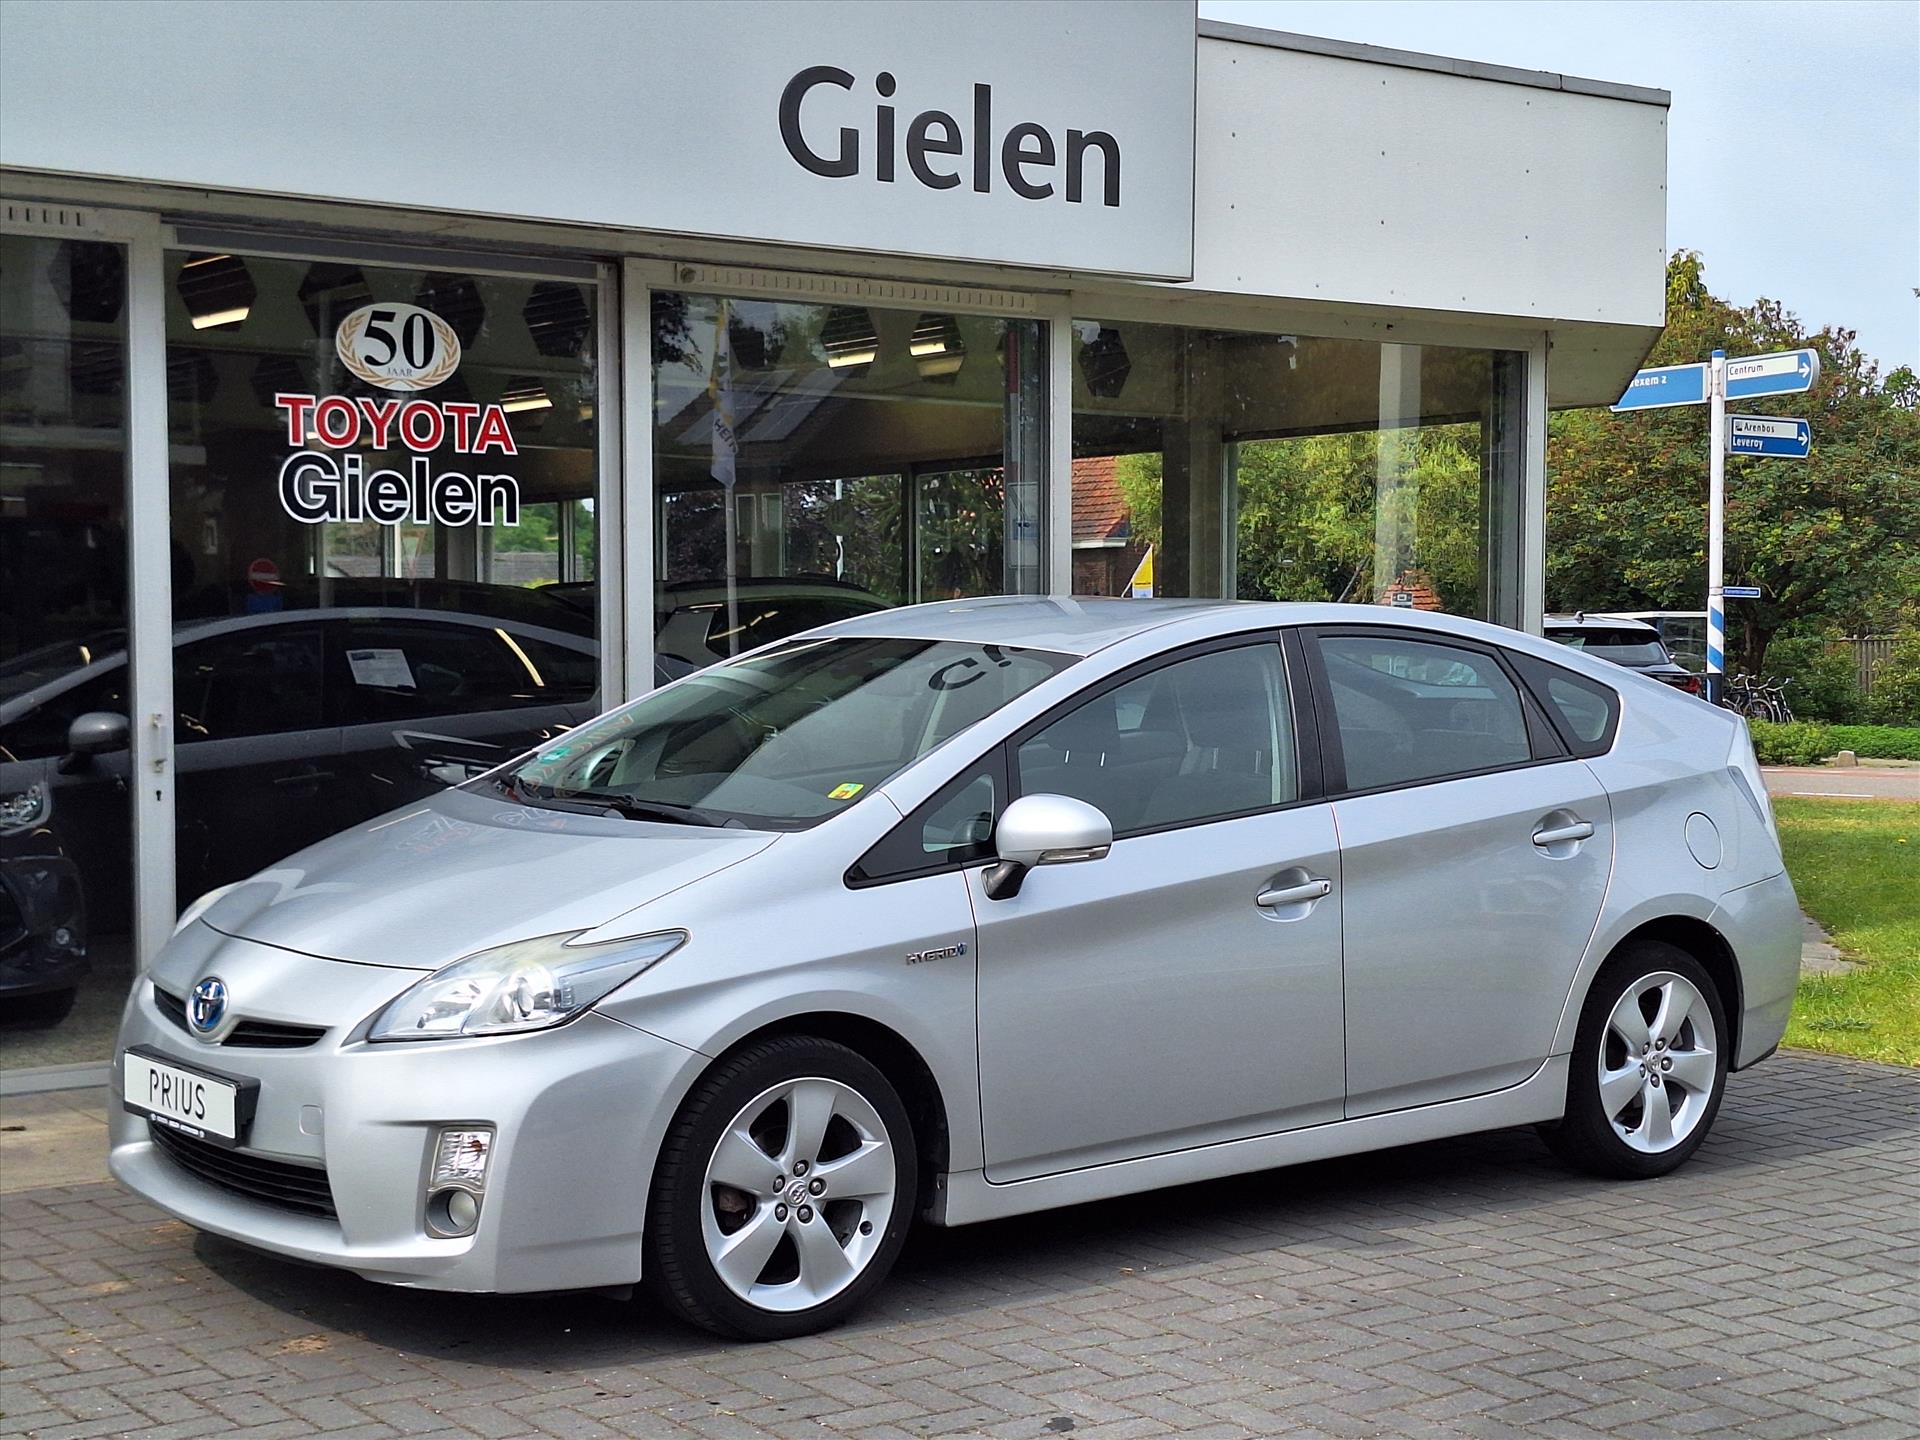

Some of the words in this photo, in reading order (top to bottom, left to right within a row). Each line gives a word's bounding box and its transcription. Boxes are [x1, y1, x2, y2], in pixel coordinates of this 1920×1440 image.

[778, 64, 1121, 207] Gielen
[363, 310, 435, 369] 50
[386, 367, 413, 377] JAAR
[1661, 375, 1668, 385] 2
[1729, 364, 1764, 376] Centrum
[275, 393, 518, 455] TOYOTA
[1744, 422, 1775, 433] Arenbos
[1732, 435, 1763, 451] Leveroy
[279, 450, 520, 526] Gielen
[906, 945, 958, 965] HYBRID
[150, 1068, 206, 1120] PRIUS
